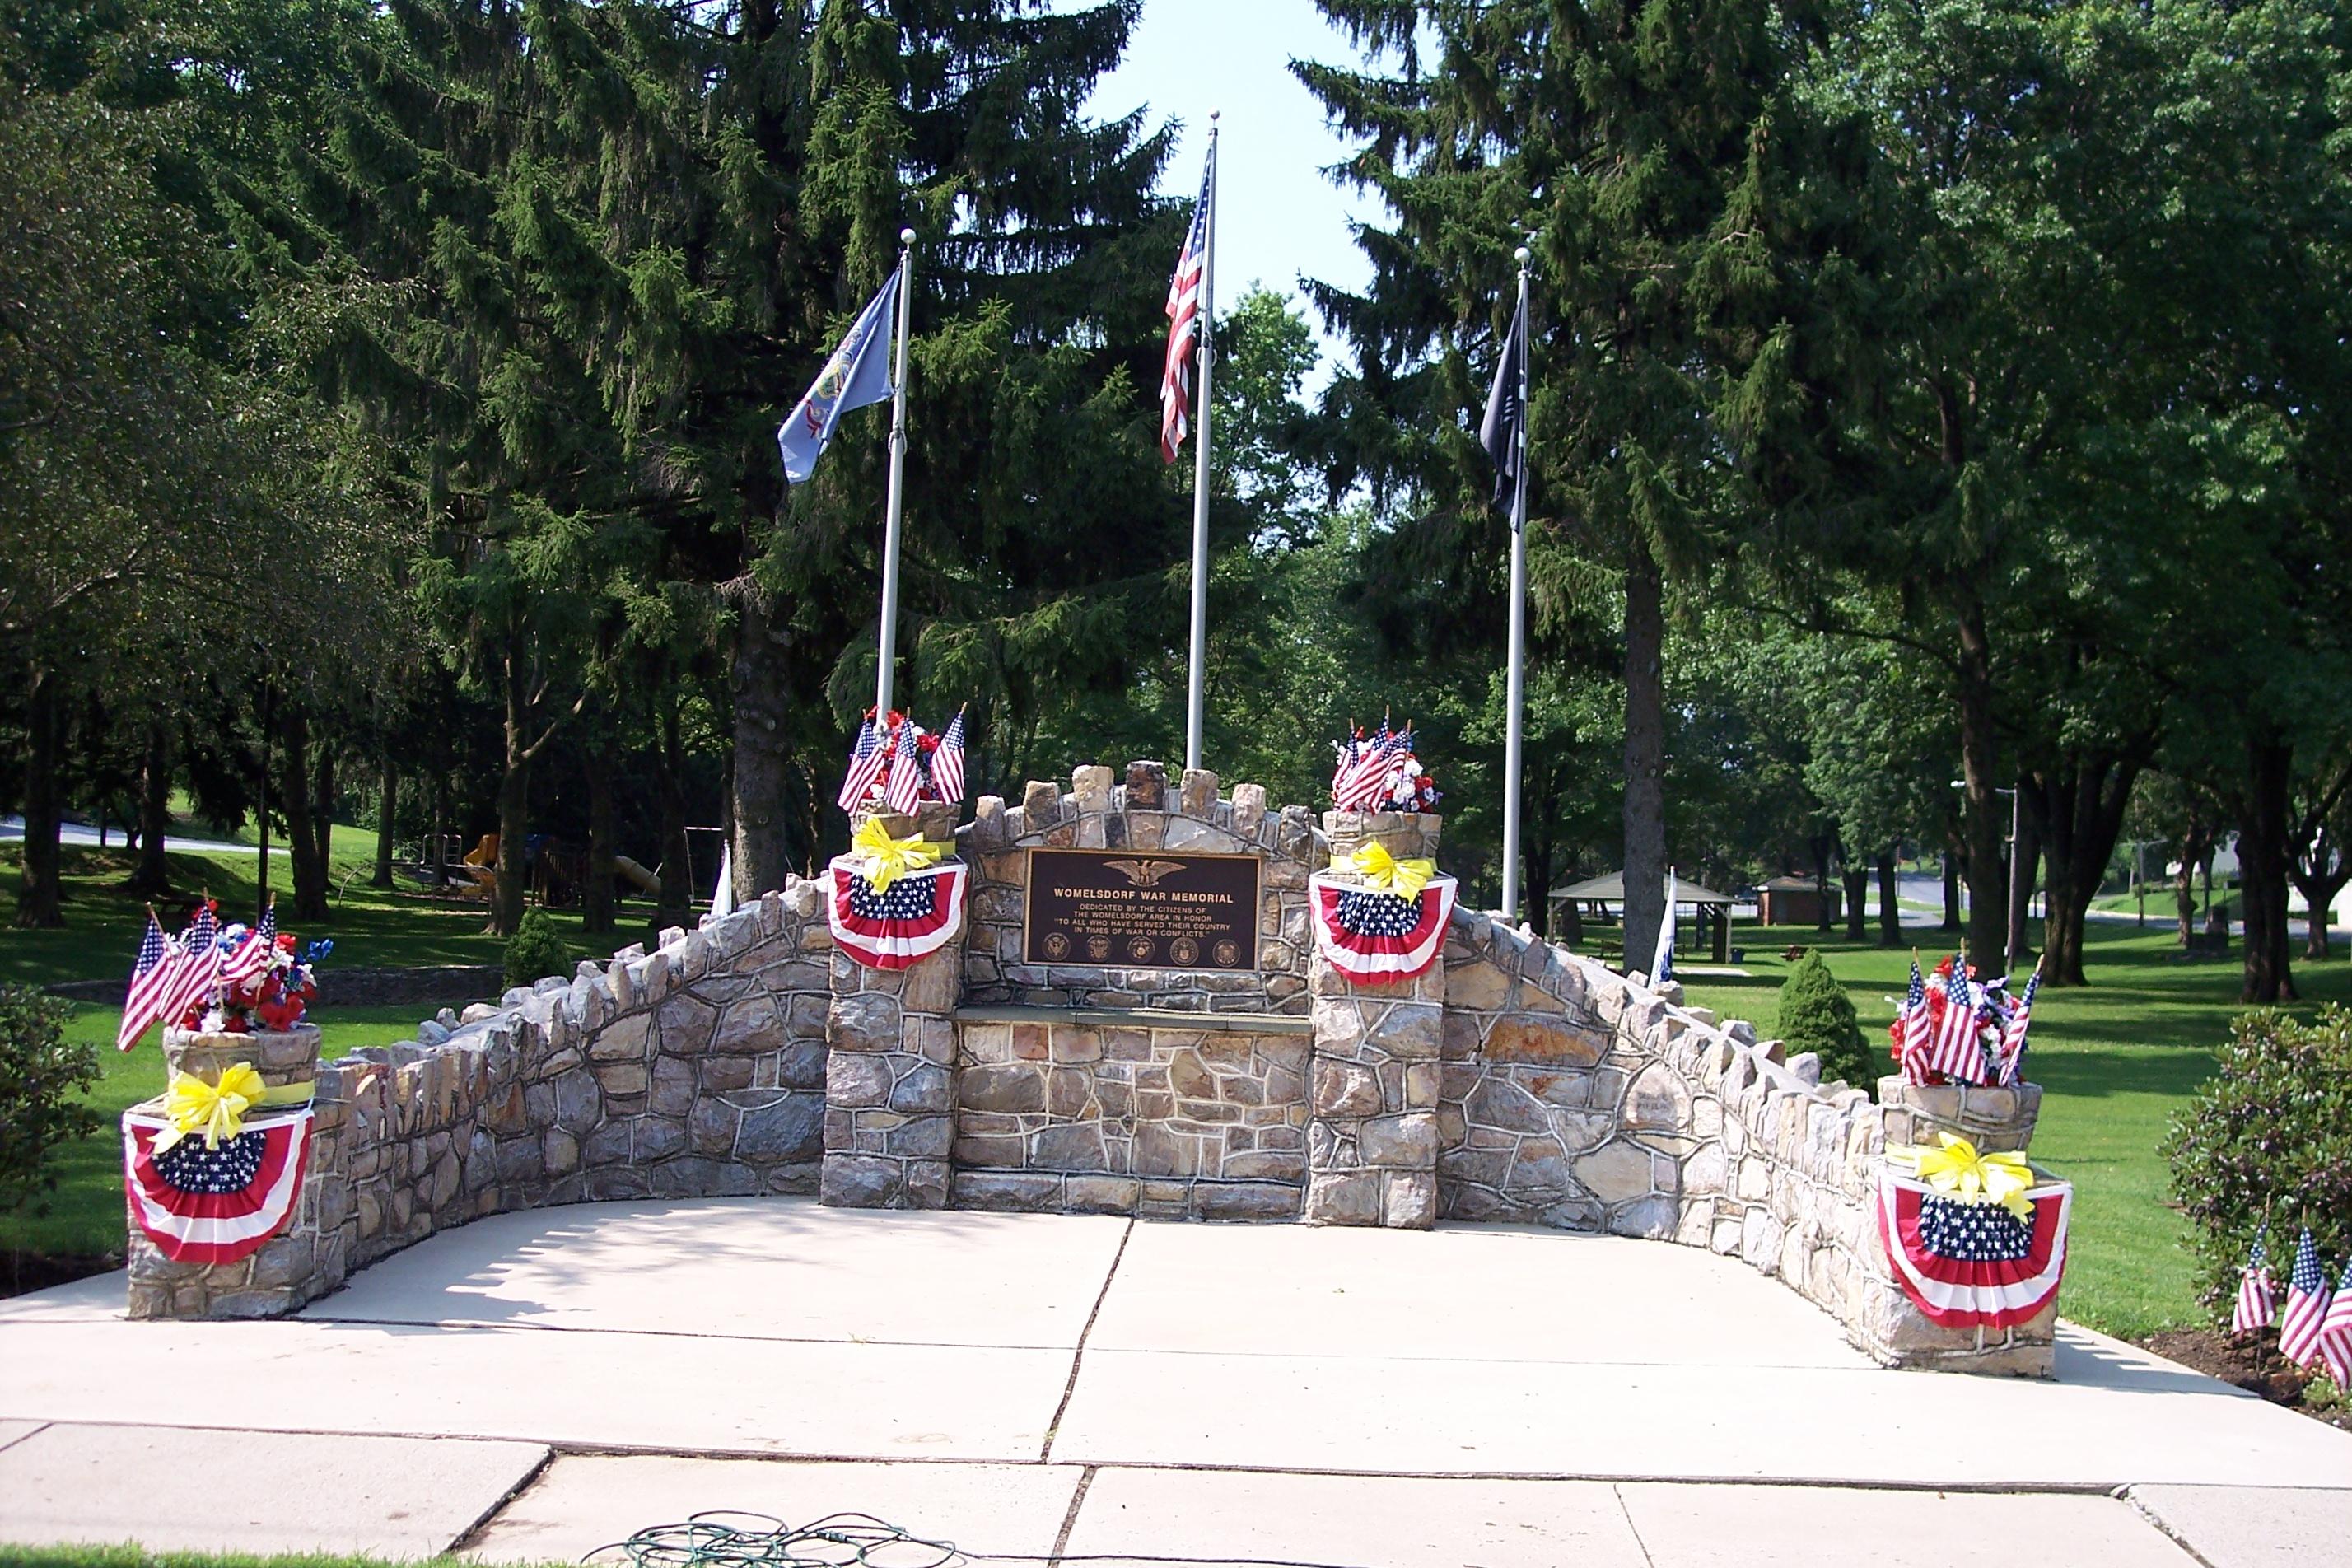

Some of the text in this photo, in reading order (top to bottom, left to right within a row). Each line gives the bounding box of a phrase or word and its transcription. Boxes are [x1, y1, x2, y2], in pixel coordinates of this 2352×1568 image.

[1054, 888, 1234, 903] WOMELSDORF WAR MEMORIAL
[1080, 903, 1123, 912] DEDICATED
[1092, 912, 1146, 920] WOMELSDORF
[1072, 918, 1086, 926] ALL
[1111, 920, 1131, 928] HAVE
[1134, 921, 1164, 929] SERVED
[1085, 926, 1109, 935] TIMES
